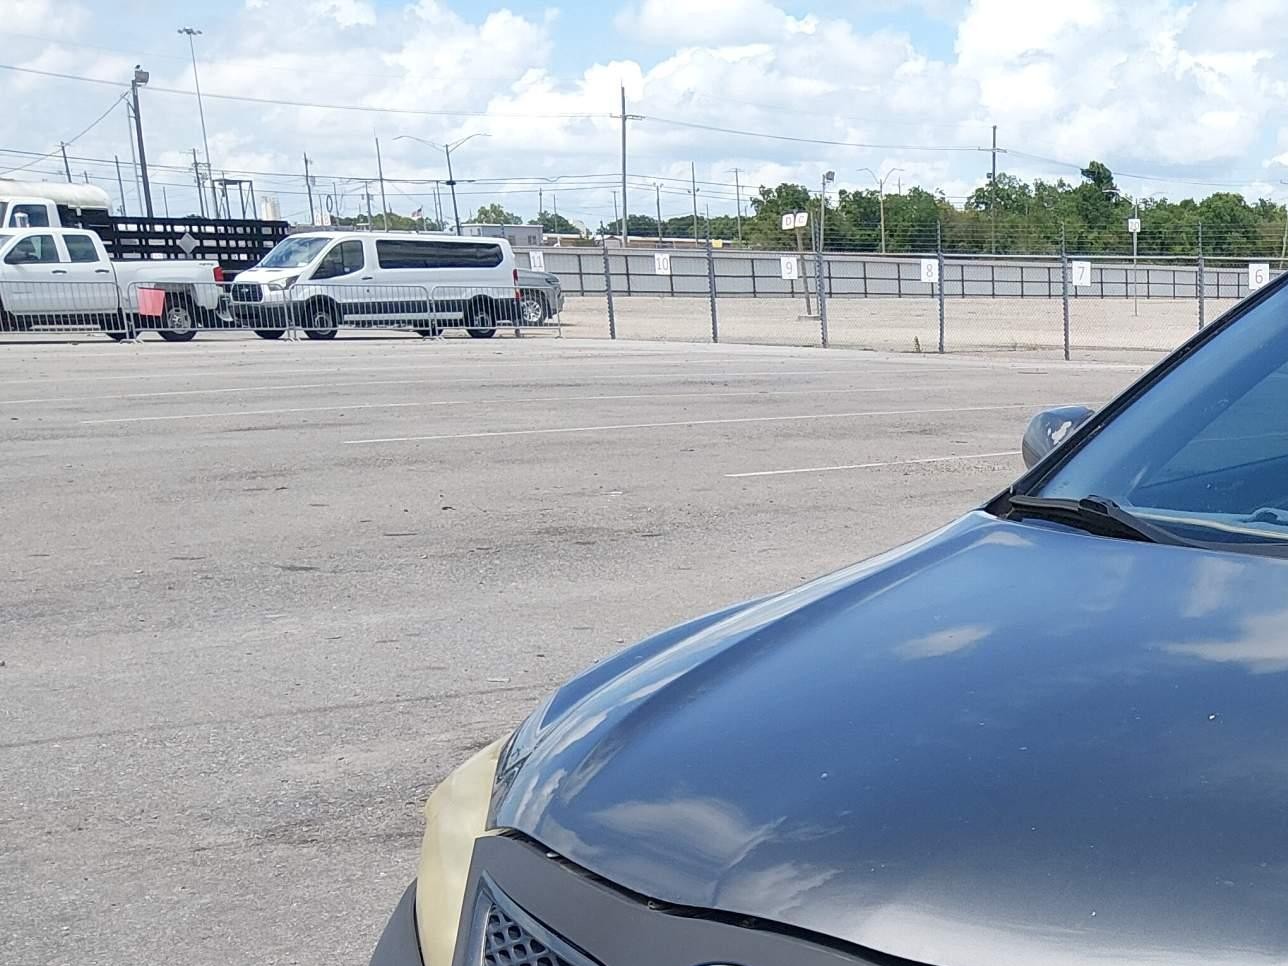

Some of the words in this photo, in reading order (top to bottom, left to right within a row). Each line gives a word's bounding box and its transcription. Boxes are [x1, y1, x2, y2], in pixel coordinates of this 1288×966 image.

[785, 216, 792, 226] D
[532, 255, 543, 268] 11
[656, 257, 669, 271] 10
[785, 261, 793, 275] 9
[926, 263, 934, 278] 8
[1077, 266, 1086, 281] 7
[1255, 269, 1264, 284] 6
